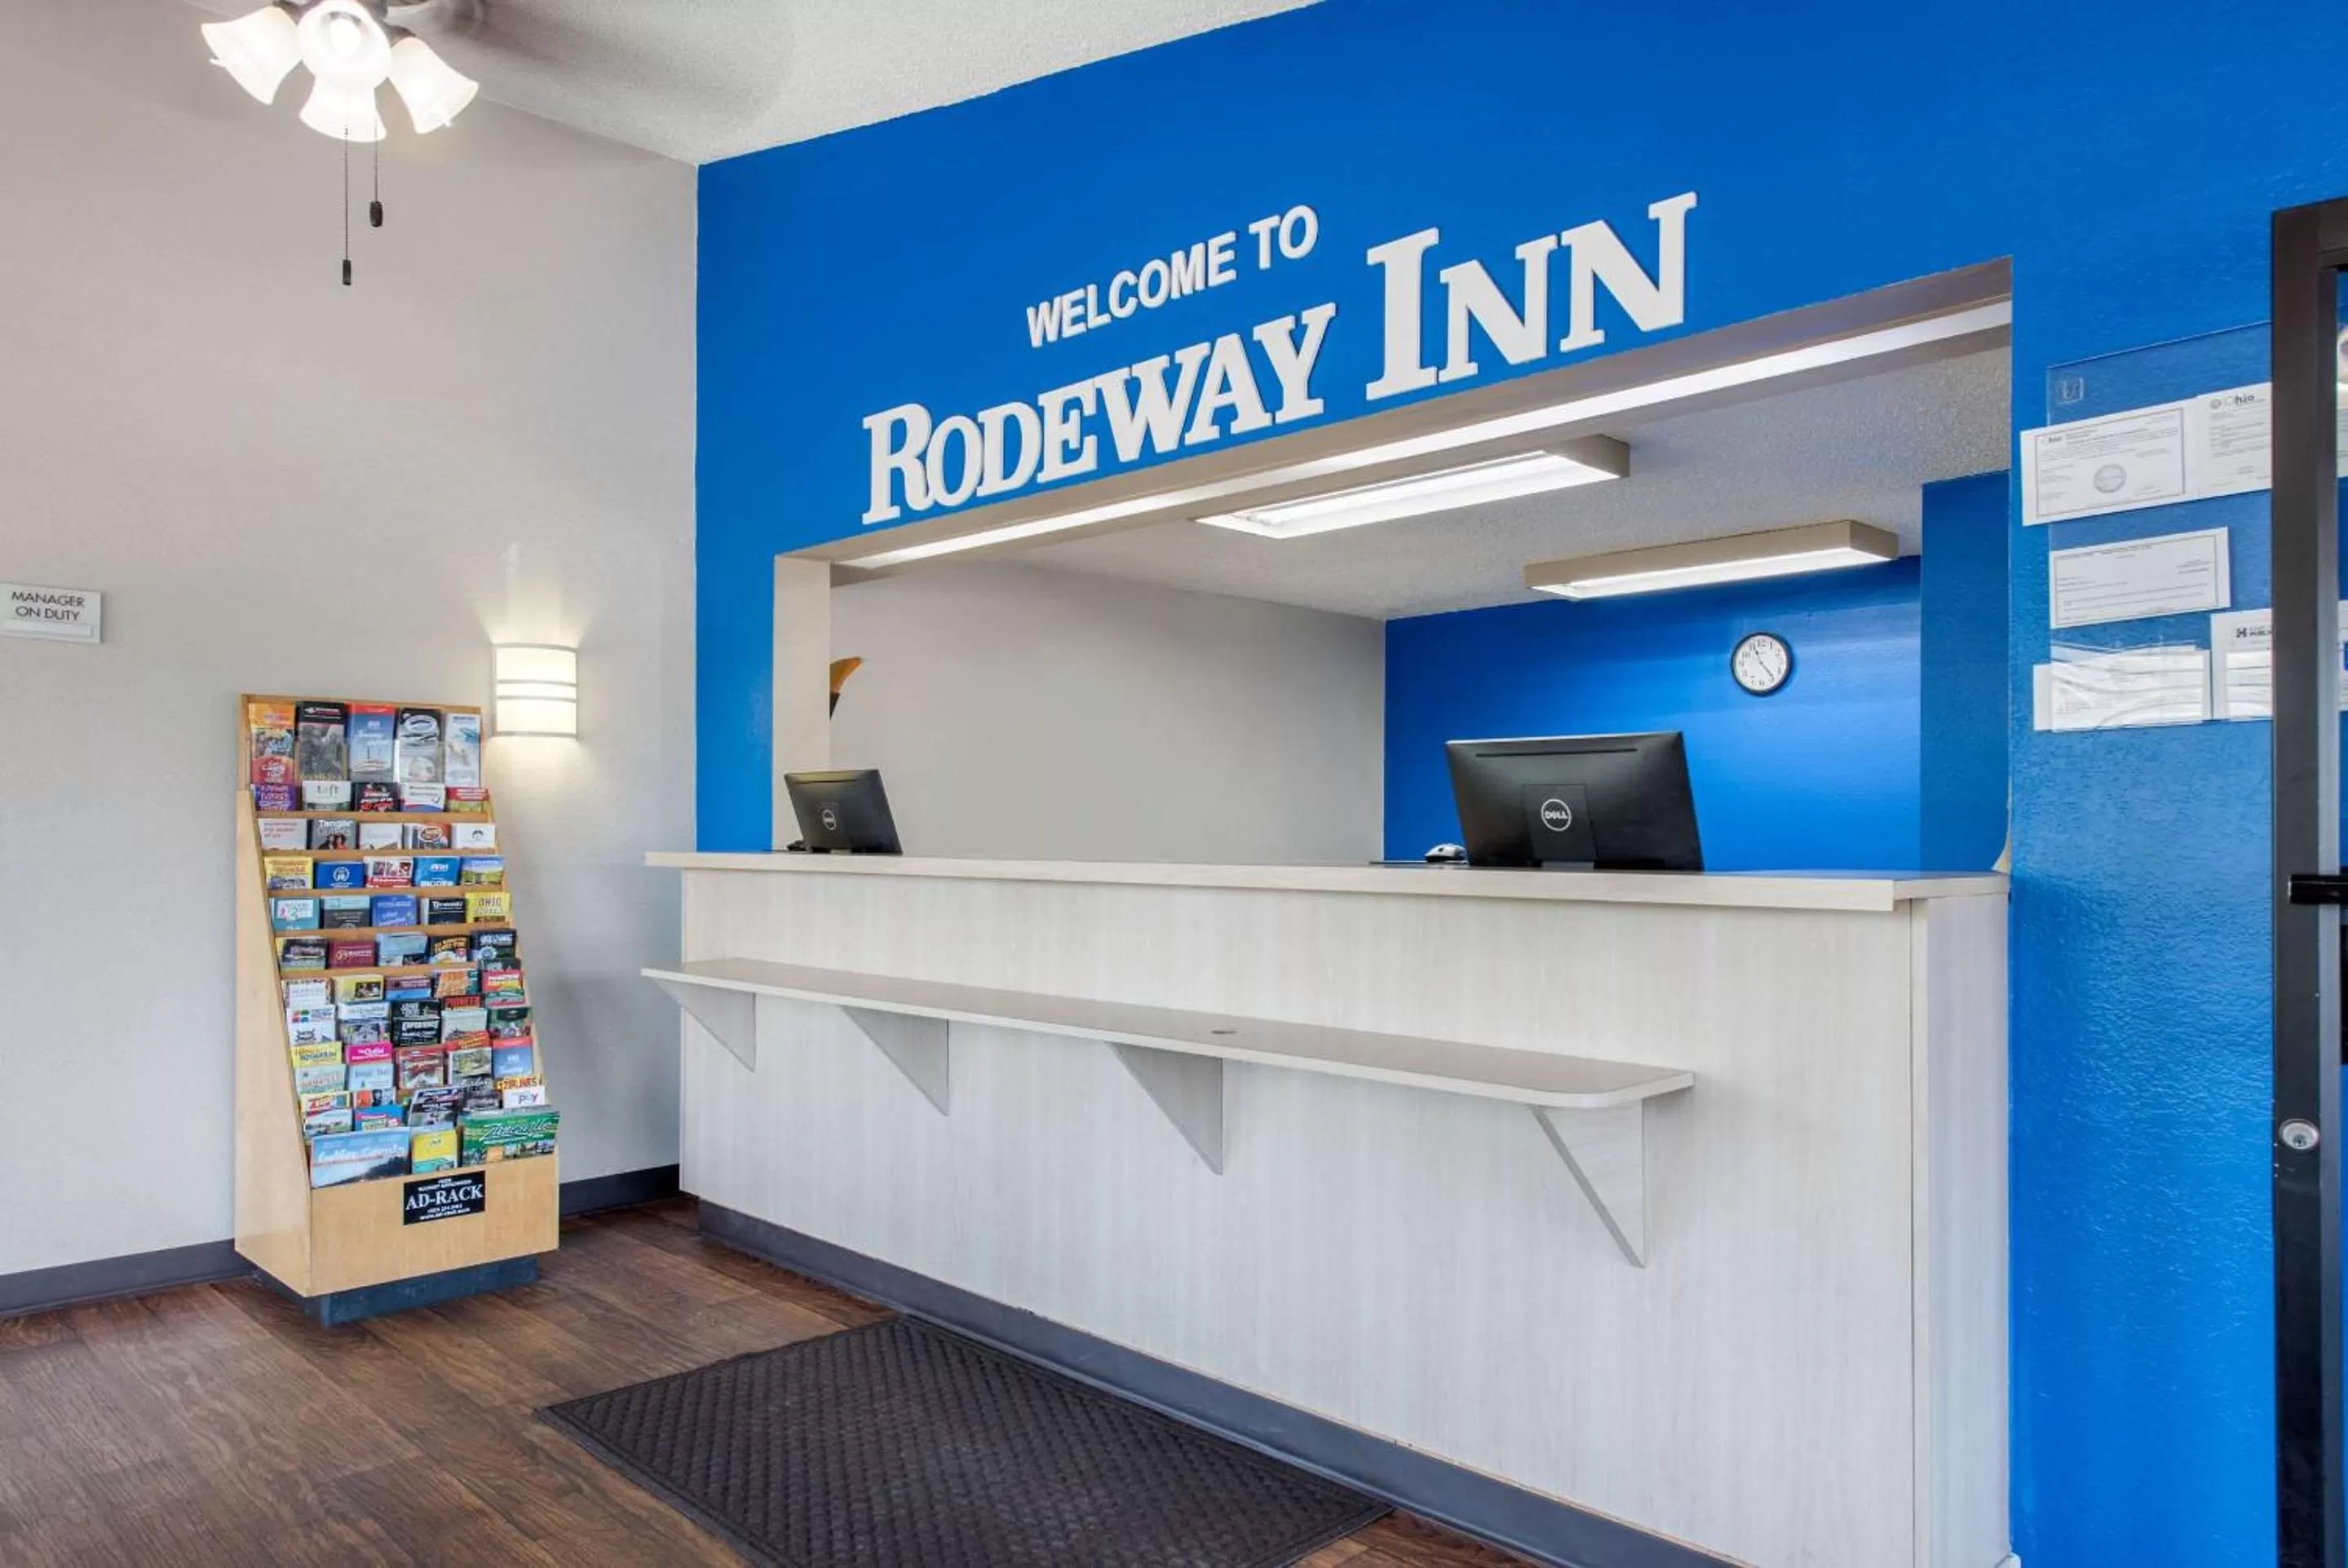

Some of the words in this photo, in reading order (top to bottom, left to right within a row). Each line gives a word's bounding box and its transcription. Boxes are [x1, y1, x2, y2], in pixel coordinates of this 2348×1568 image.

[1027, 231, 1237, 348] WELCOME
[1249, 205, 1320, 270] TO
[862, 303, 1337, 526] RODEWAY
[1366, 191, 1697, 402] INN
[11, 590, 86, 607] MANAGER
[15, 605, 40, 617] ON
[45, 607, 80, 621] DUTY
[1545, 810, 1568, 819] DELL
[405, 1184, 484, 1210] AD-RACK
